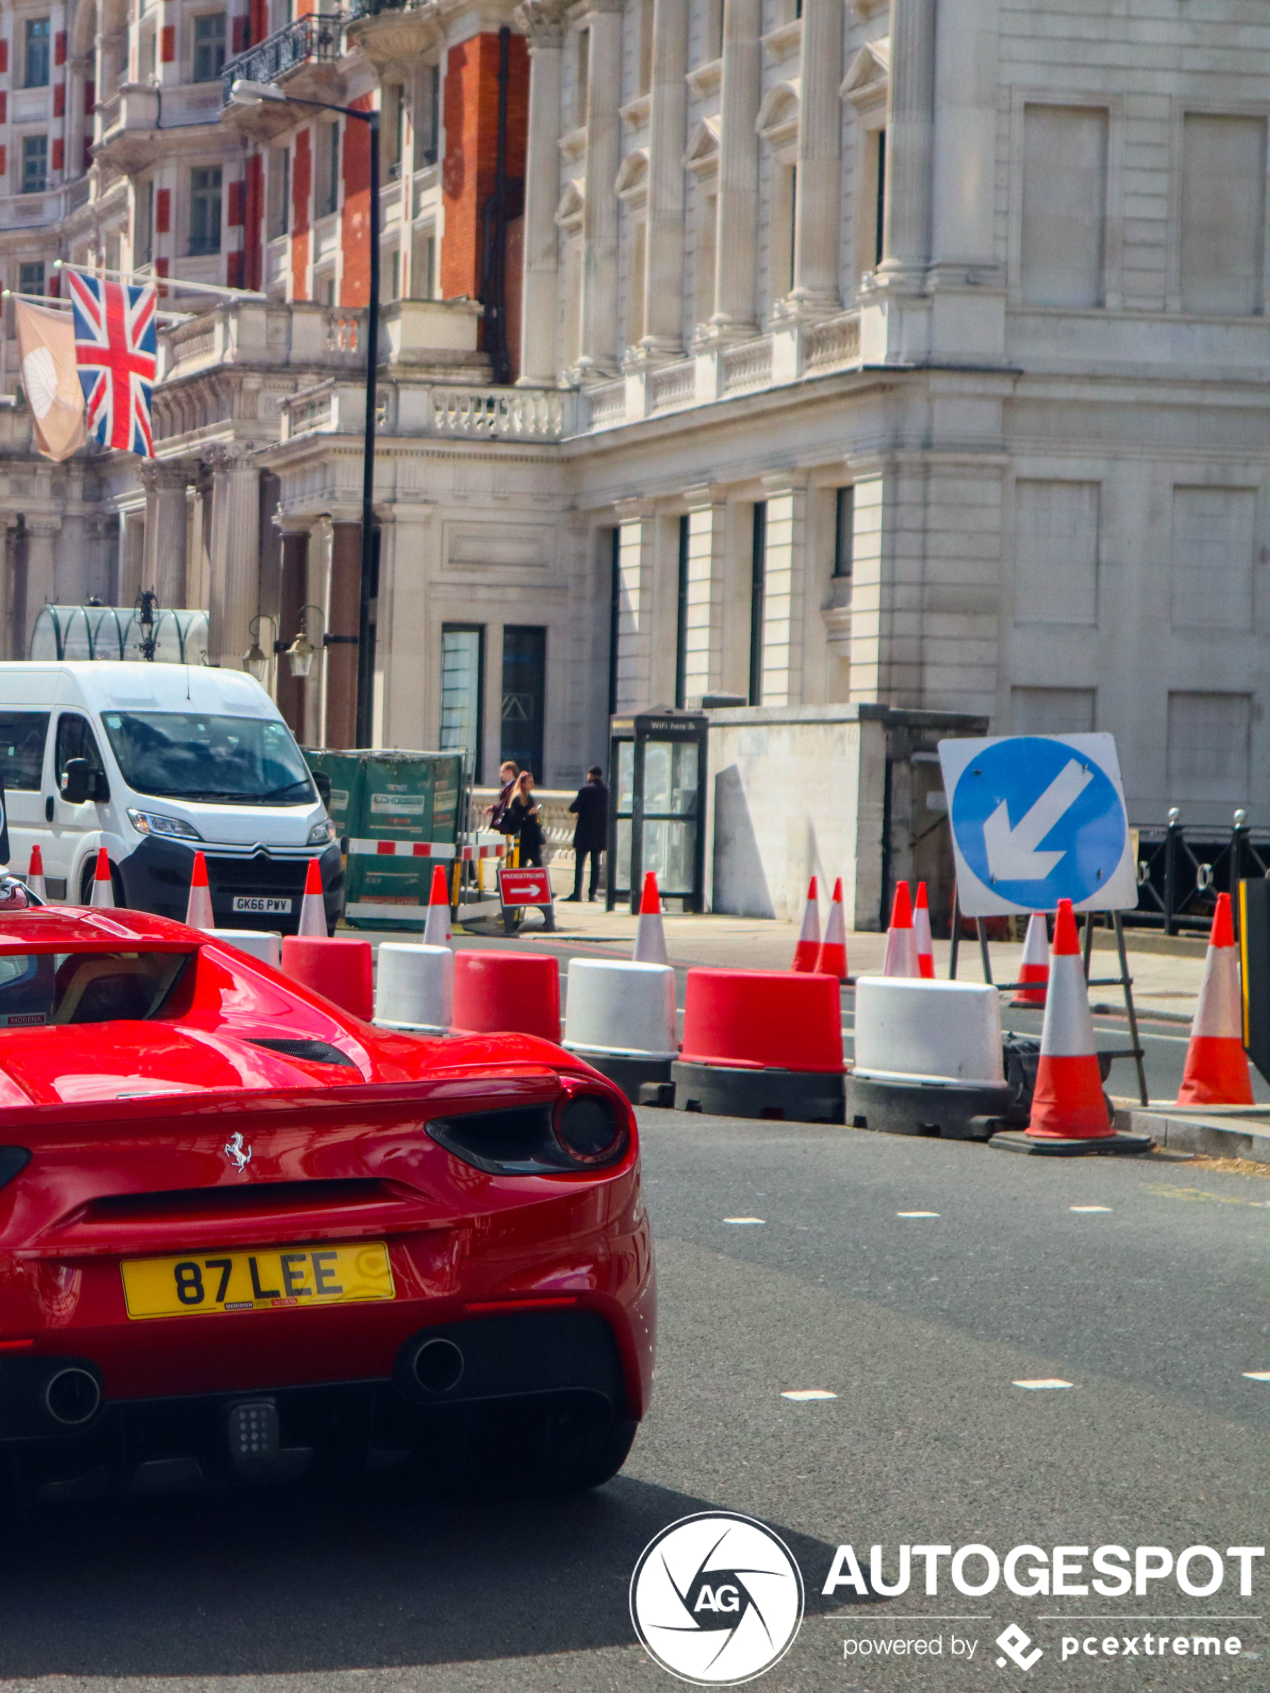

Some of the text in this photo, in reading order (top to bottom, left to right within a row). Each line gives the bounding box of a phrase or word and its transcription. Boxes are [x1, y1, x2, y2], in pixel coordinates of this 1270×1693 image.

[651, 721, 687, 731] WiFi here
[237, 898, 287, 911] GK66 PWV
[10, 1015, 43, 1024] MODENA
[173, 1251, 344, 1306] 87 LEE
[225, 1302, 253, 1310] MERIDIEN
